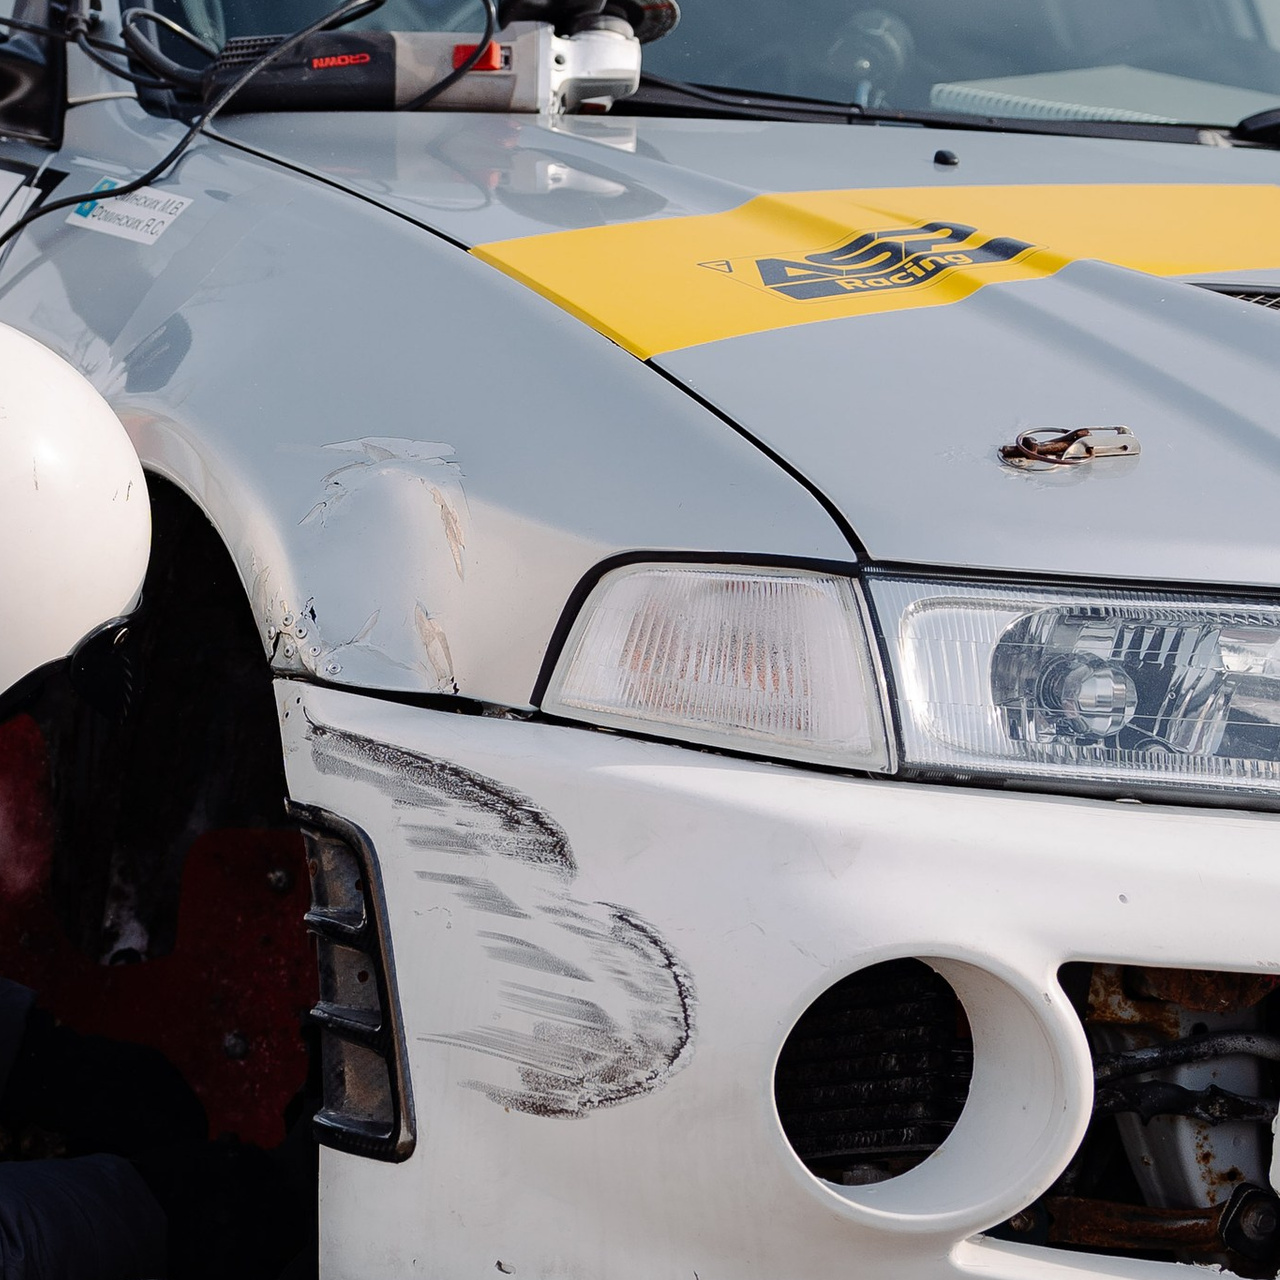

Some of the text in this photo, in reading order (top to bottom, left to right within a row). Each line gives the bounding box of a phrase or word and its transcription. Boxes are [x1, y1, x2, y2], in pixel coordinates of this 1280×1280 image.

[311, 52, 371, 69] CROWN
[755, 221, 979, 288] ASP
[841, 252, 973, 292] Racing
